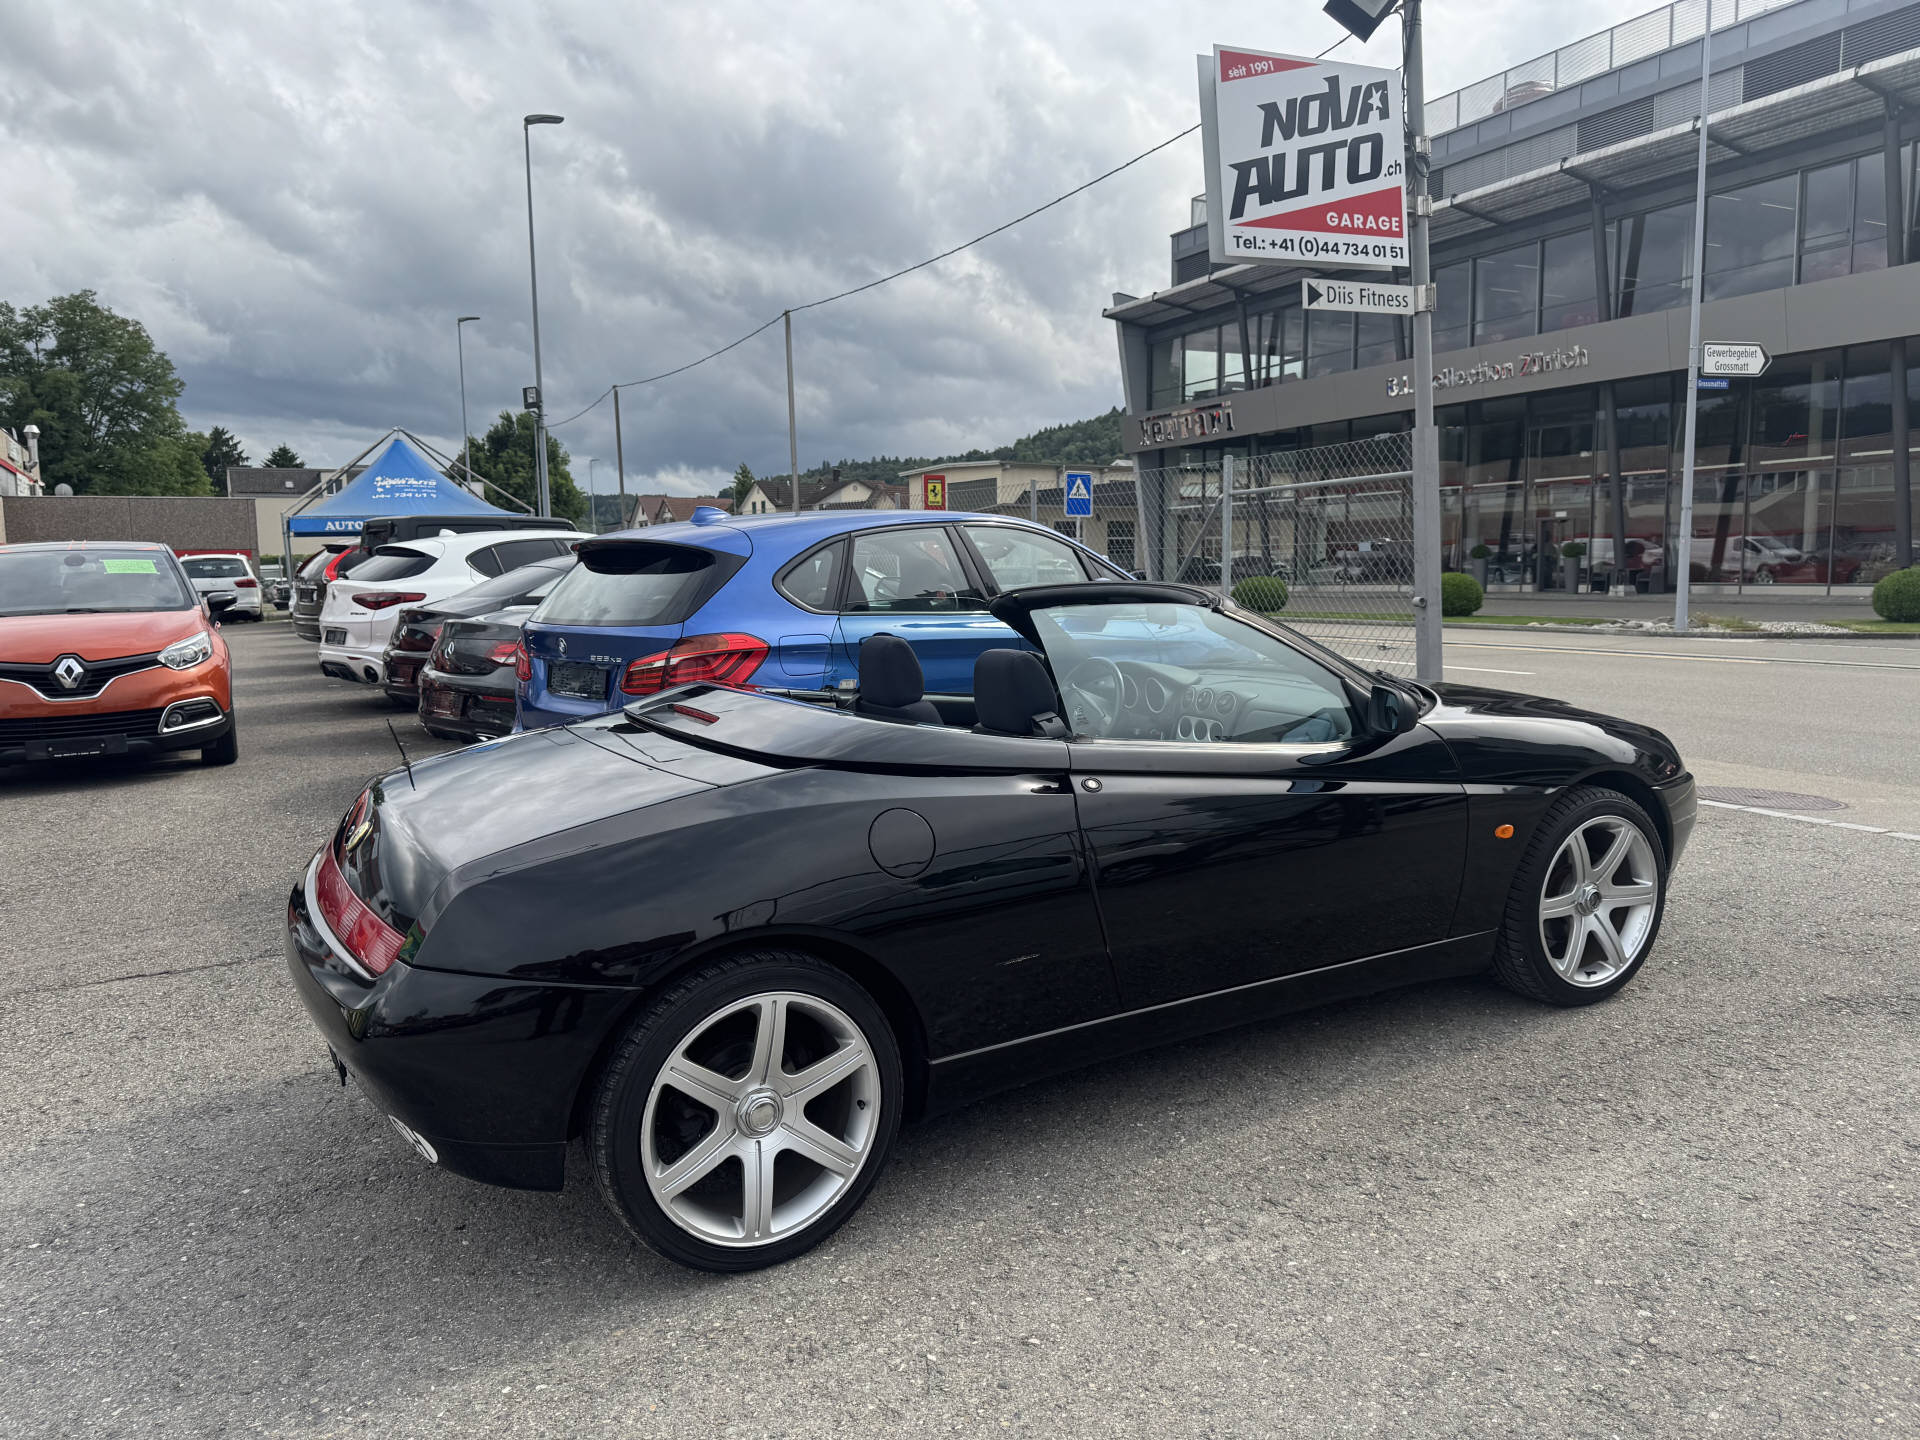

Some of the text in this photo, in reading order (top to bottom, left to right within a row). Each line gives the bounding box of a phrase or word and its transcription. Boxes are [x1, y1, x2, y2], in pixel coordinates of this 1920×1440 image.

[1228, 60, 1275, 78] seit 1991
[1256, 74, 1390, 149] NOVA
[1326, 211, 1400, 232] GARAGE
[1233, 235, 1404, 259] Tel.: +41 (0)44 734 01 51
[1327, 286, 1409, 308] Diis Fitness
[1706, 347, 1757, 360] Gewerbegebiet
[1432, 360, 1514, 389] ollection
[1519, 344, 1589, 376] Zürich
[1714, 361, 1749, 371] Grossmatt
[1139, 400, 1236, 447] Ferrari
[325, 520, 364, 531] AUTO
